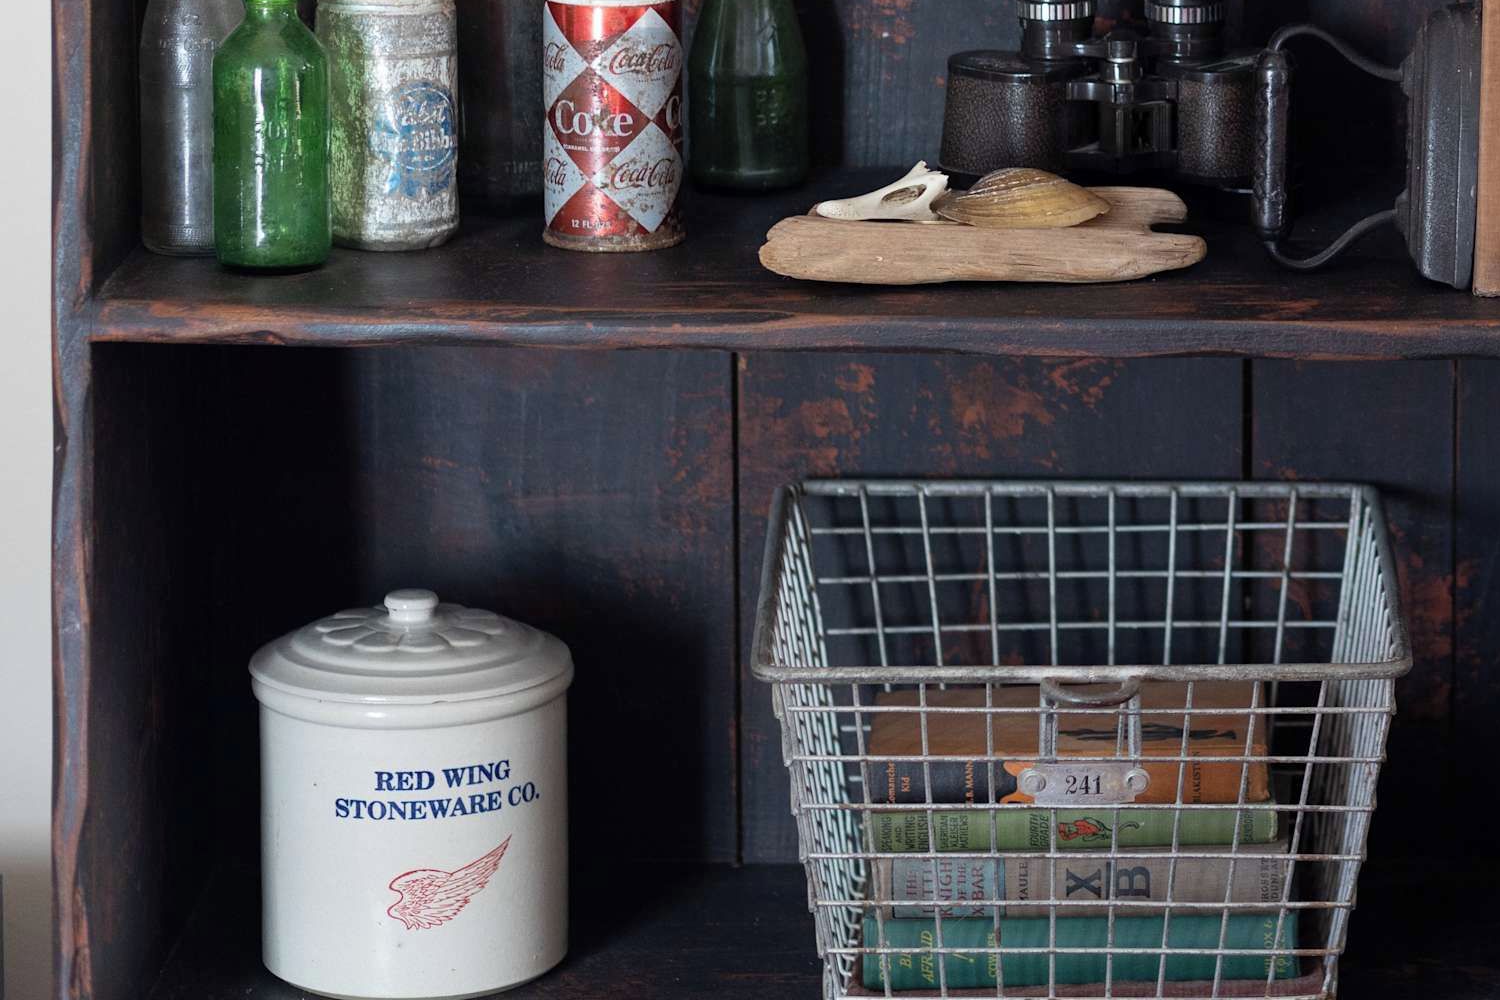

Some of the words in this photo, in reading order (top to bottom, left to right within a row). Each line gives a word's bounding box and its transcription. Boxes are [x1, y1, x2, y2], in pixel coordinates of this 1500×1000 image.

[555, 98, 634, 137] Coke
[571, 219, 580, 228] 12
[374, 770, 436, 792] RED
[442, 759, 511, 787] WING
[901, 775, 911, 793] Kid
[1064, 774, 1104, 796] 241
[334, 790, 502, 821] STONEWARE
[508, 780, 541, 807] CO.
[1029, 813, 1040, 848] FOURTH
[1039, 814, 1050, 848] GRADE
